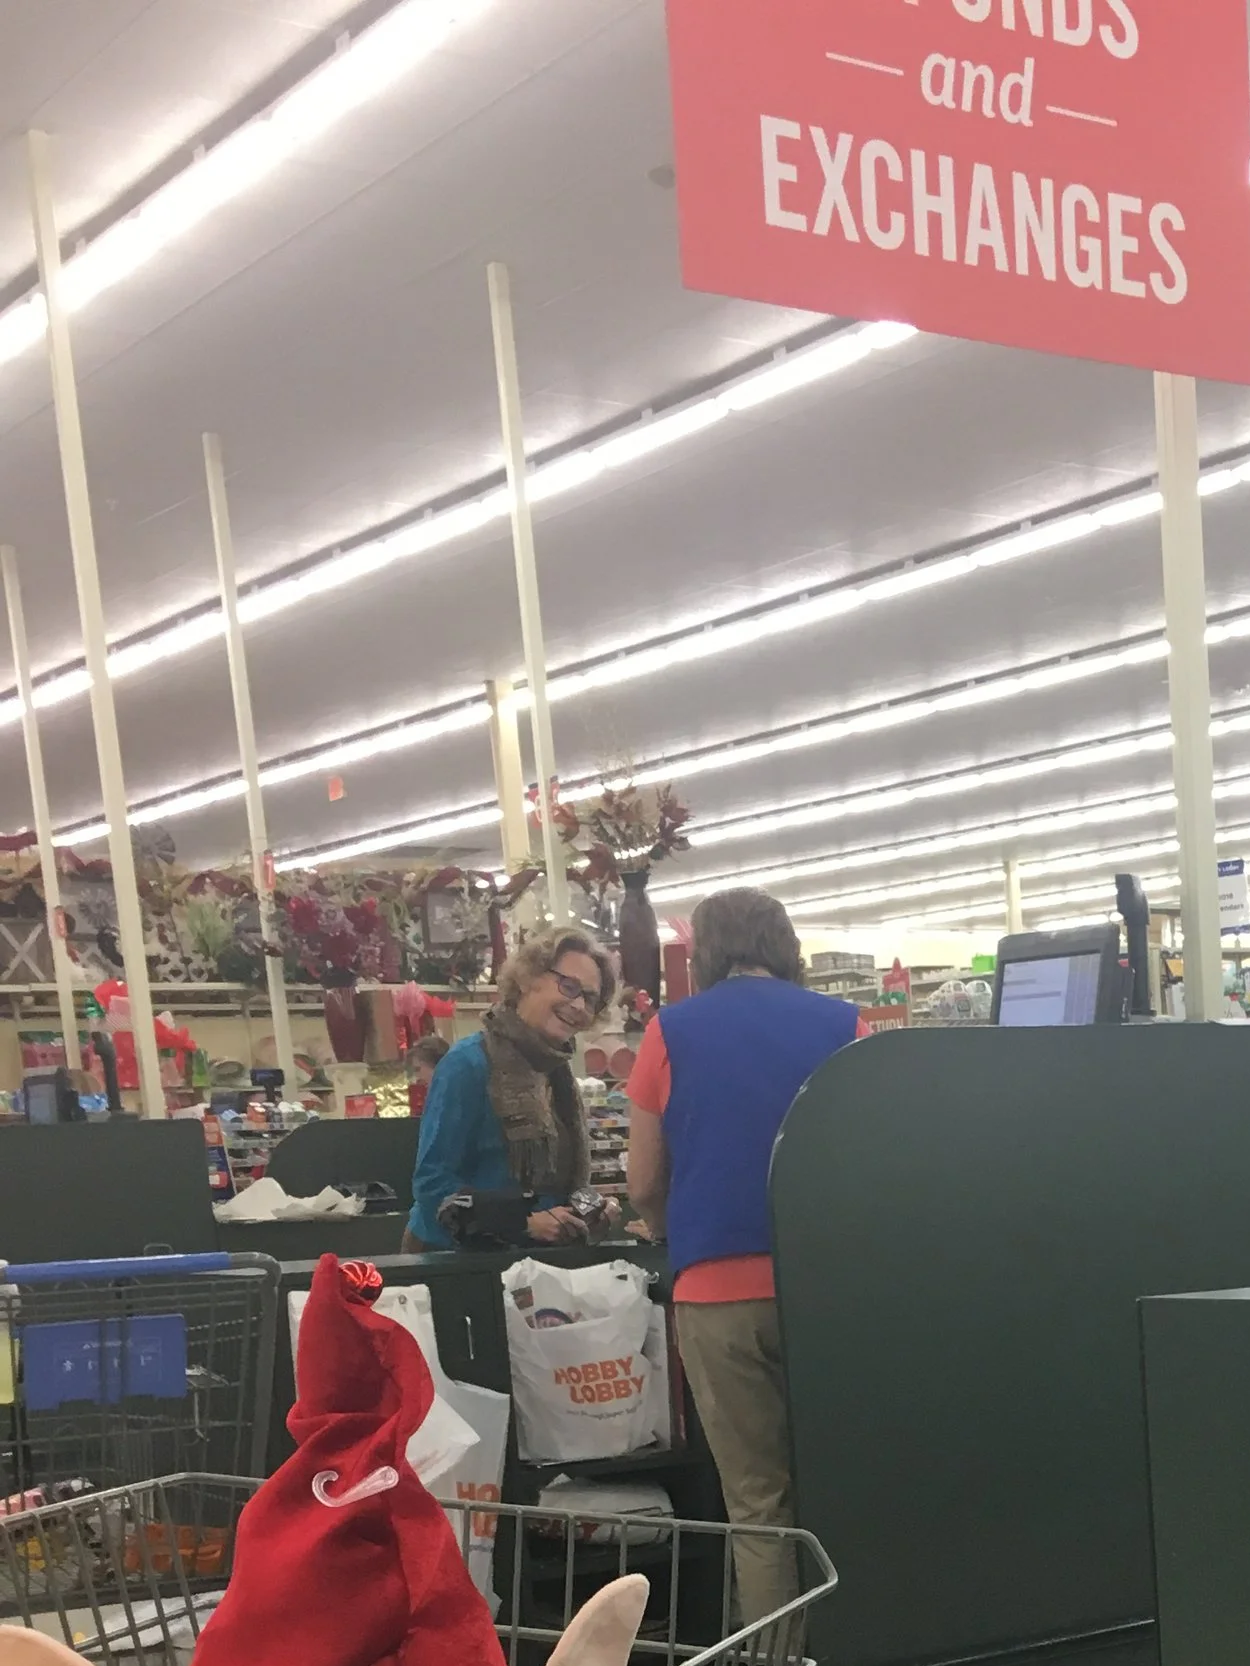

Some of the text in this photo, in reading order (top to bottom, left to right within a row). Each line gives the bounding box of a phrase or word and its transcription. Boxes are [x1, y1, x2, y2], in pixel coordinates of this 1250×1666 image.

[920, 53, 1035, 127] and
[759, 114, 1189, 305] EXCHANGES
[554, 1356, 633, 1385] HOBBY
[569, 1374, 645, 1404] LOBBY
